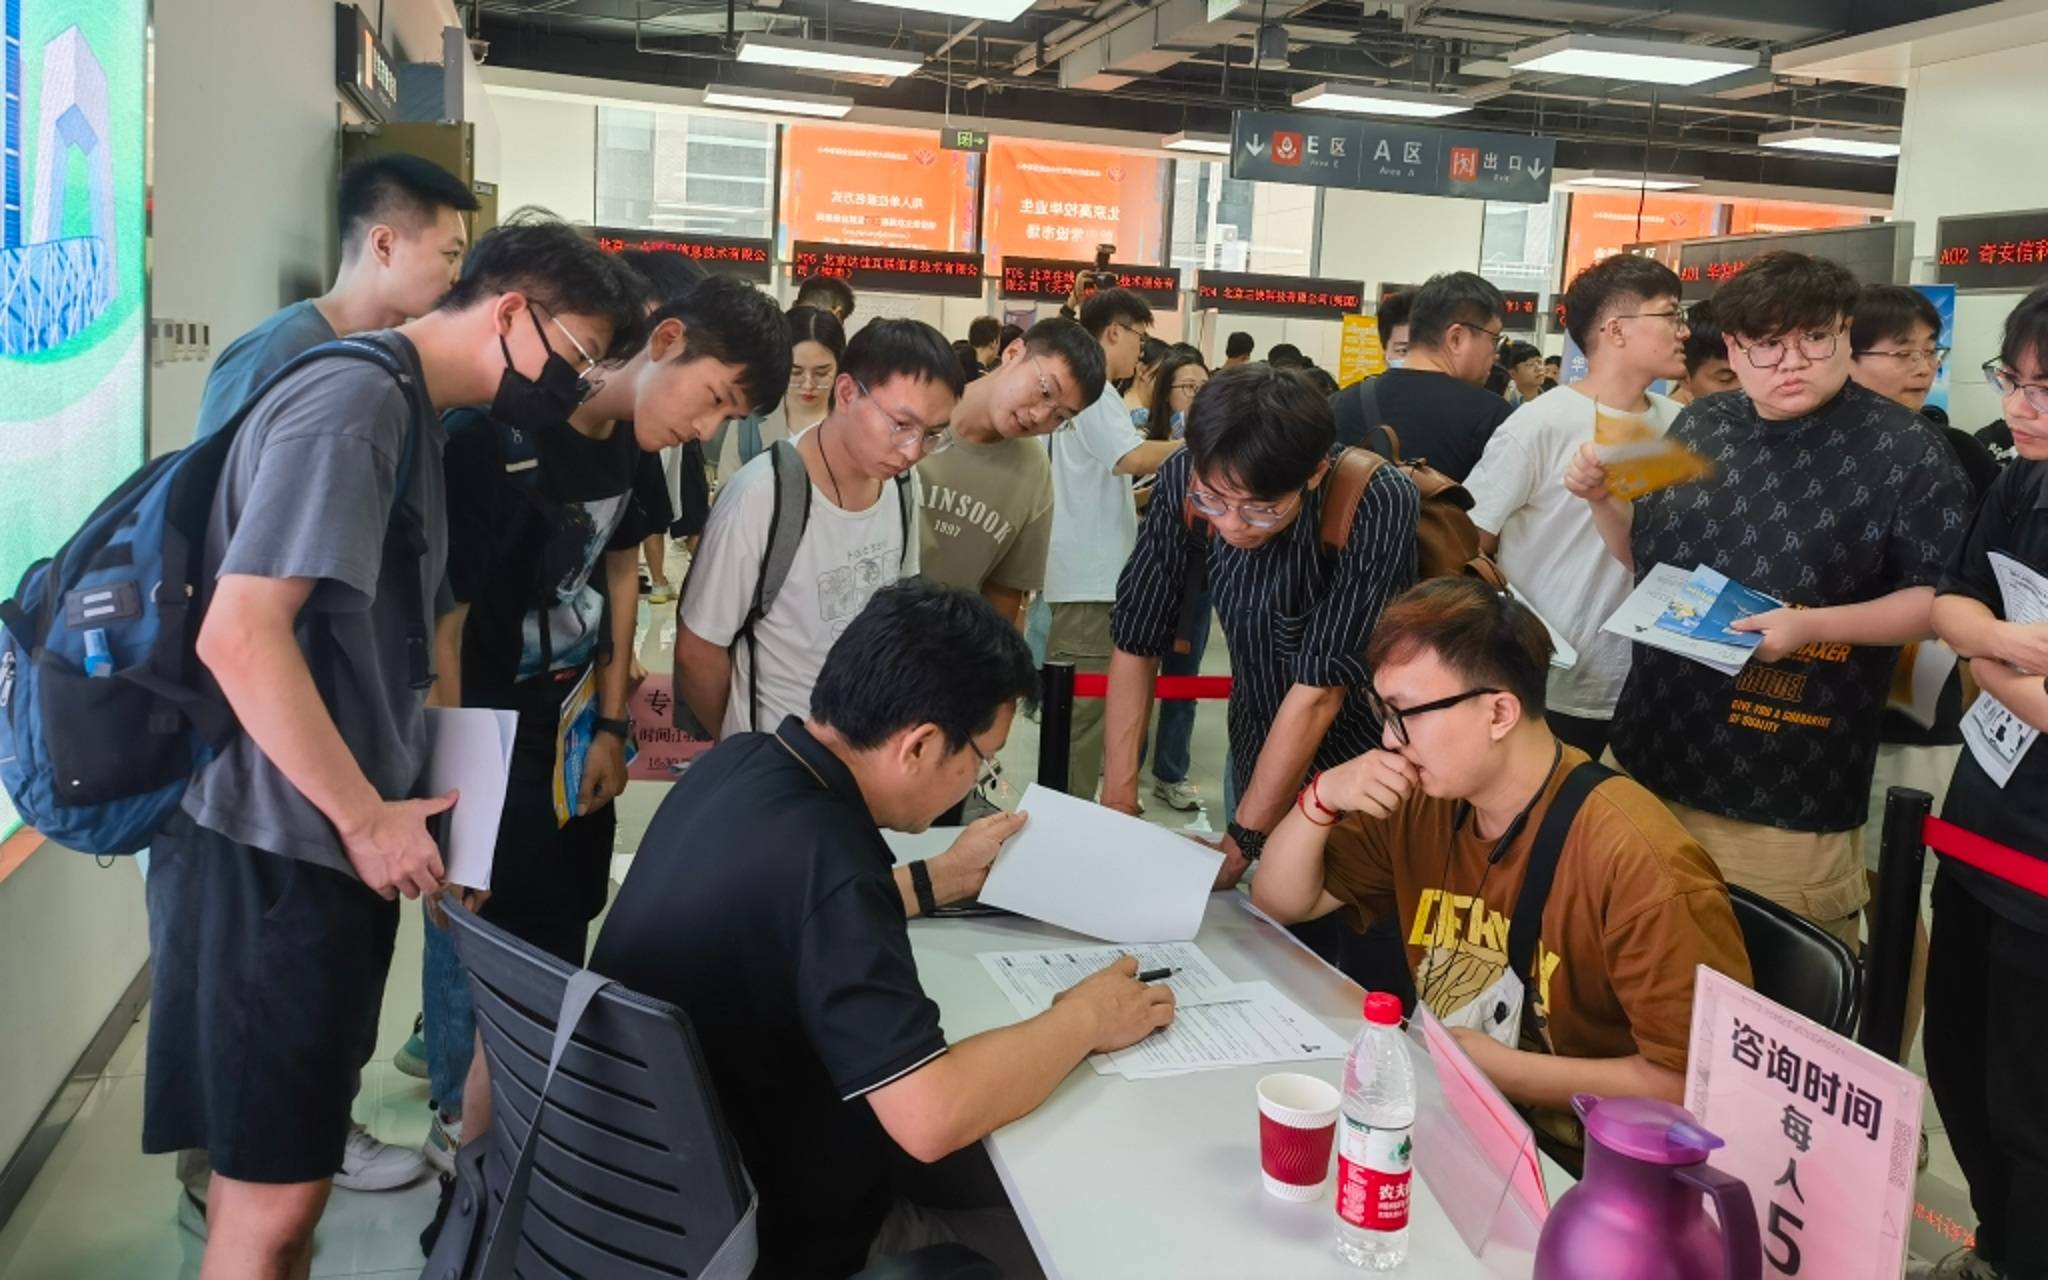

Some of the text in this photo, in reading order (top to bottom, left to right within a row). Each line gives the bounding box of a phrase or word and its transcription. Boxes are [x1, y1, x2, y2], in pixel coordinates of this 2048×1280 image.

[1483, 152, 1522, 170] 出口
[1940, 247, 1969, 265] A02
[1681, 266, 1699, 281] A01
[645, 689, 673, 718] 专
[1730, 1016, 1884, 1143] 咨询时间
